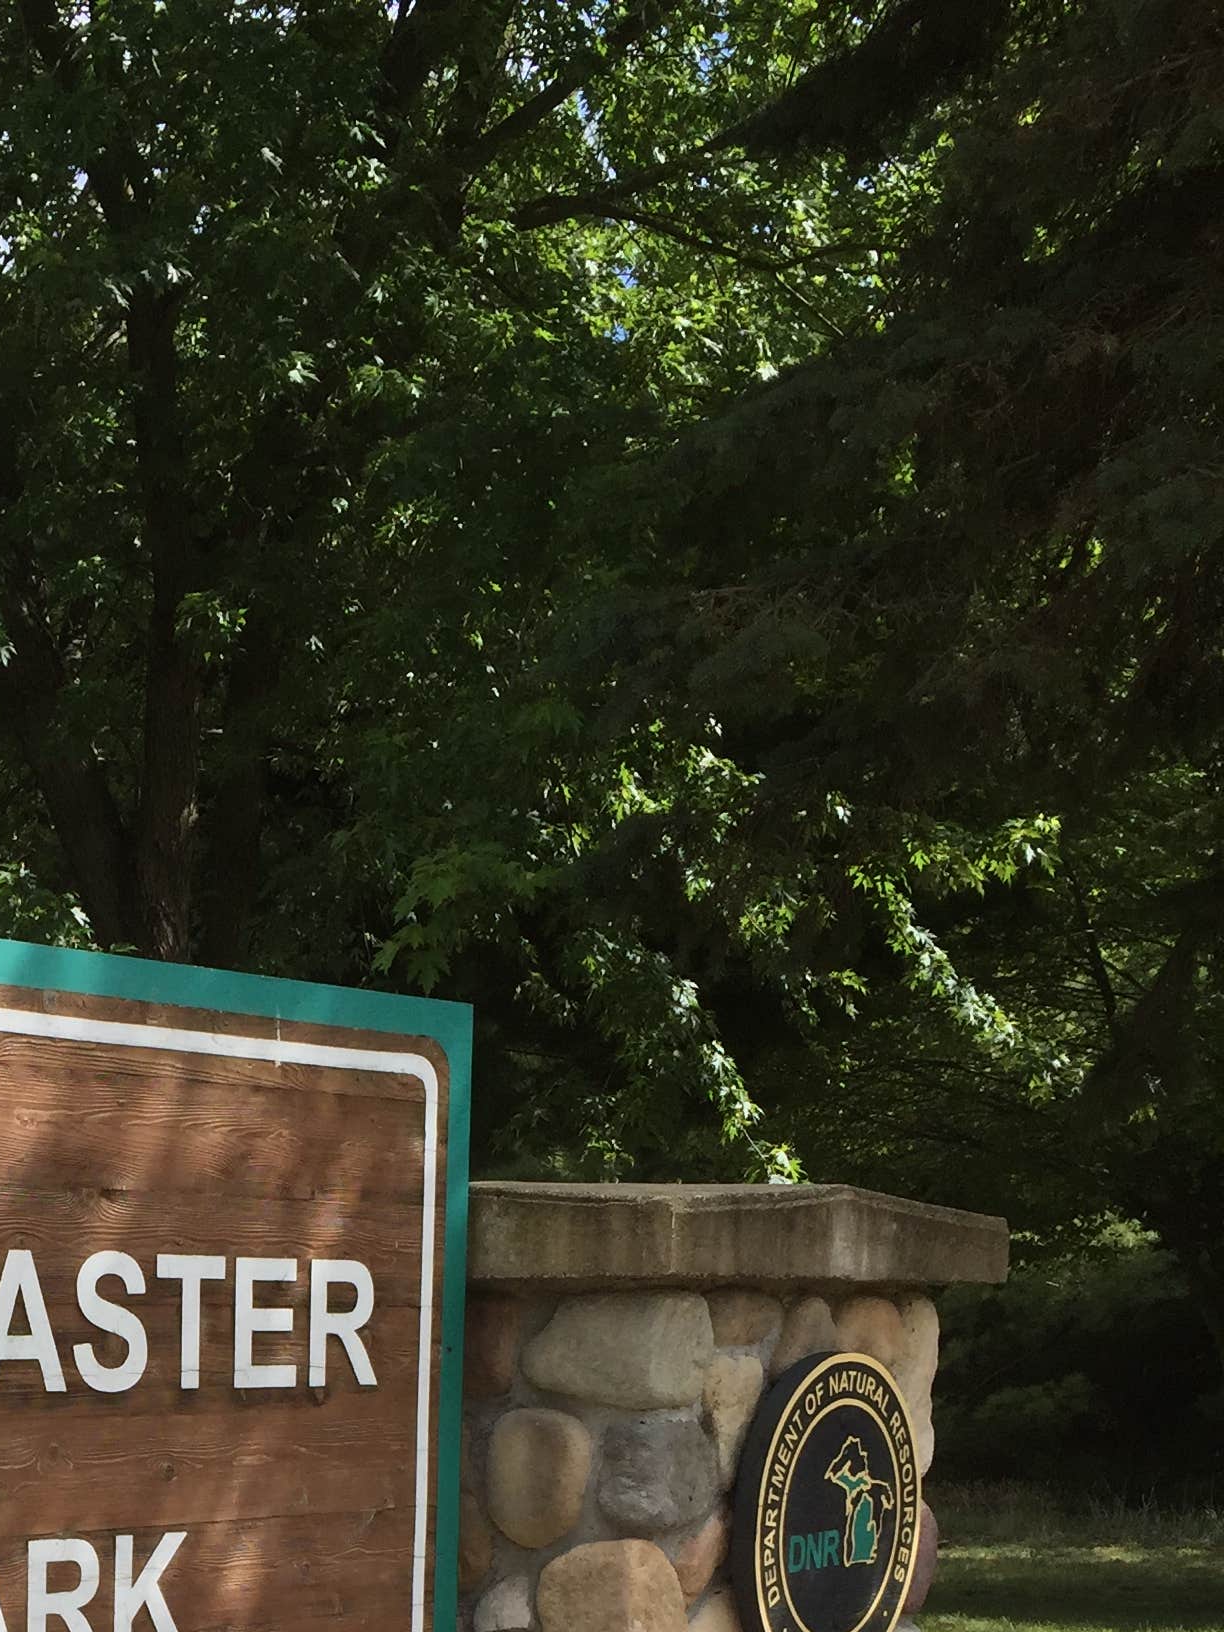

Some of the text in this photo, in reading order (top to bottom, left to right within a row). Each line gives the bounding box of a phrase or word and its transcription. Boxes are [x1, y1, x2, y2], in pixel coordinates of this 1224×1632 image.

[765, 1370, 914, 1608] DEPARTMENT OF NATURAL RESOURCES
[788, 1528, 841, 1574] DNR
